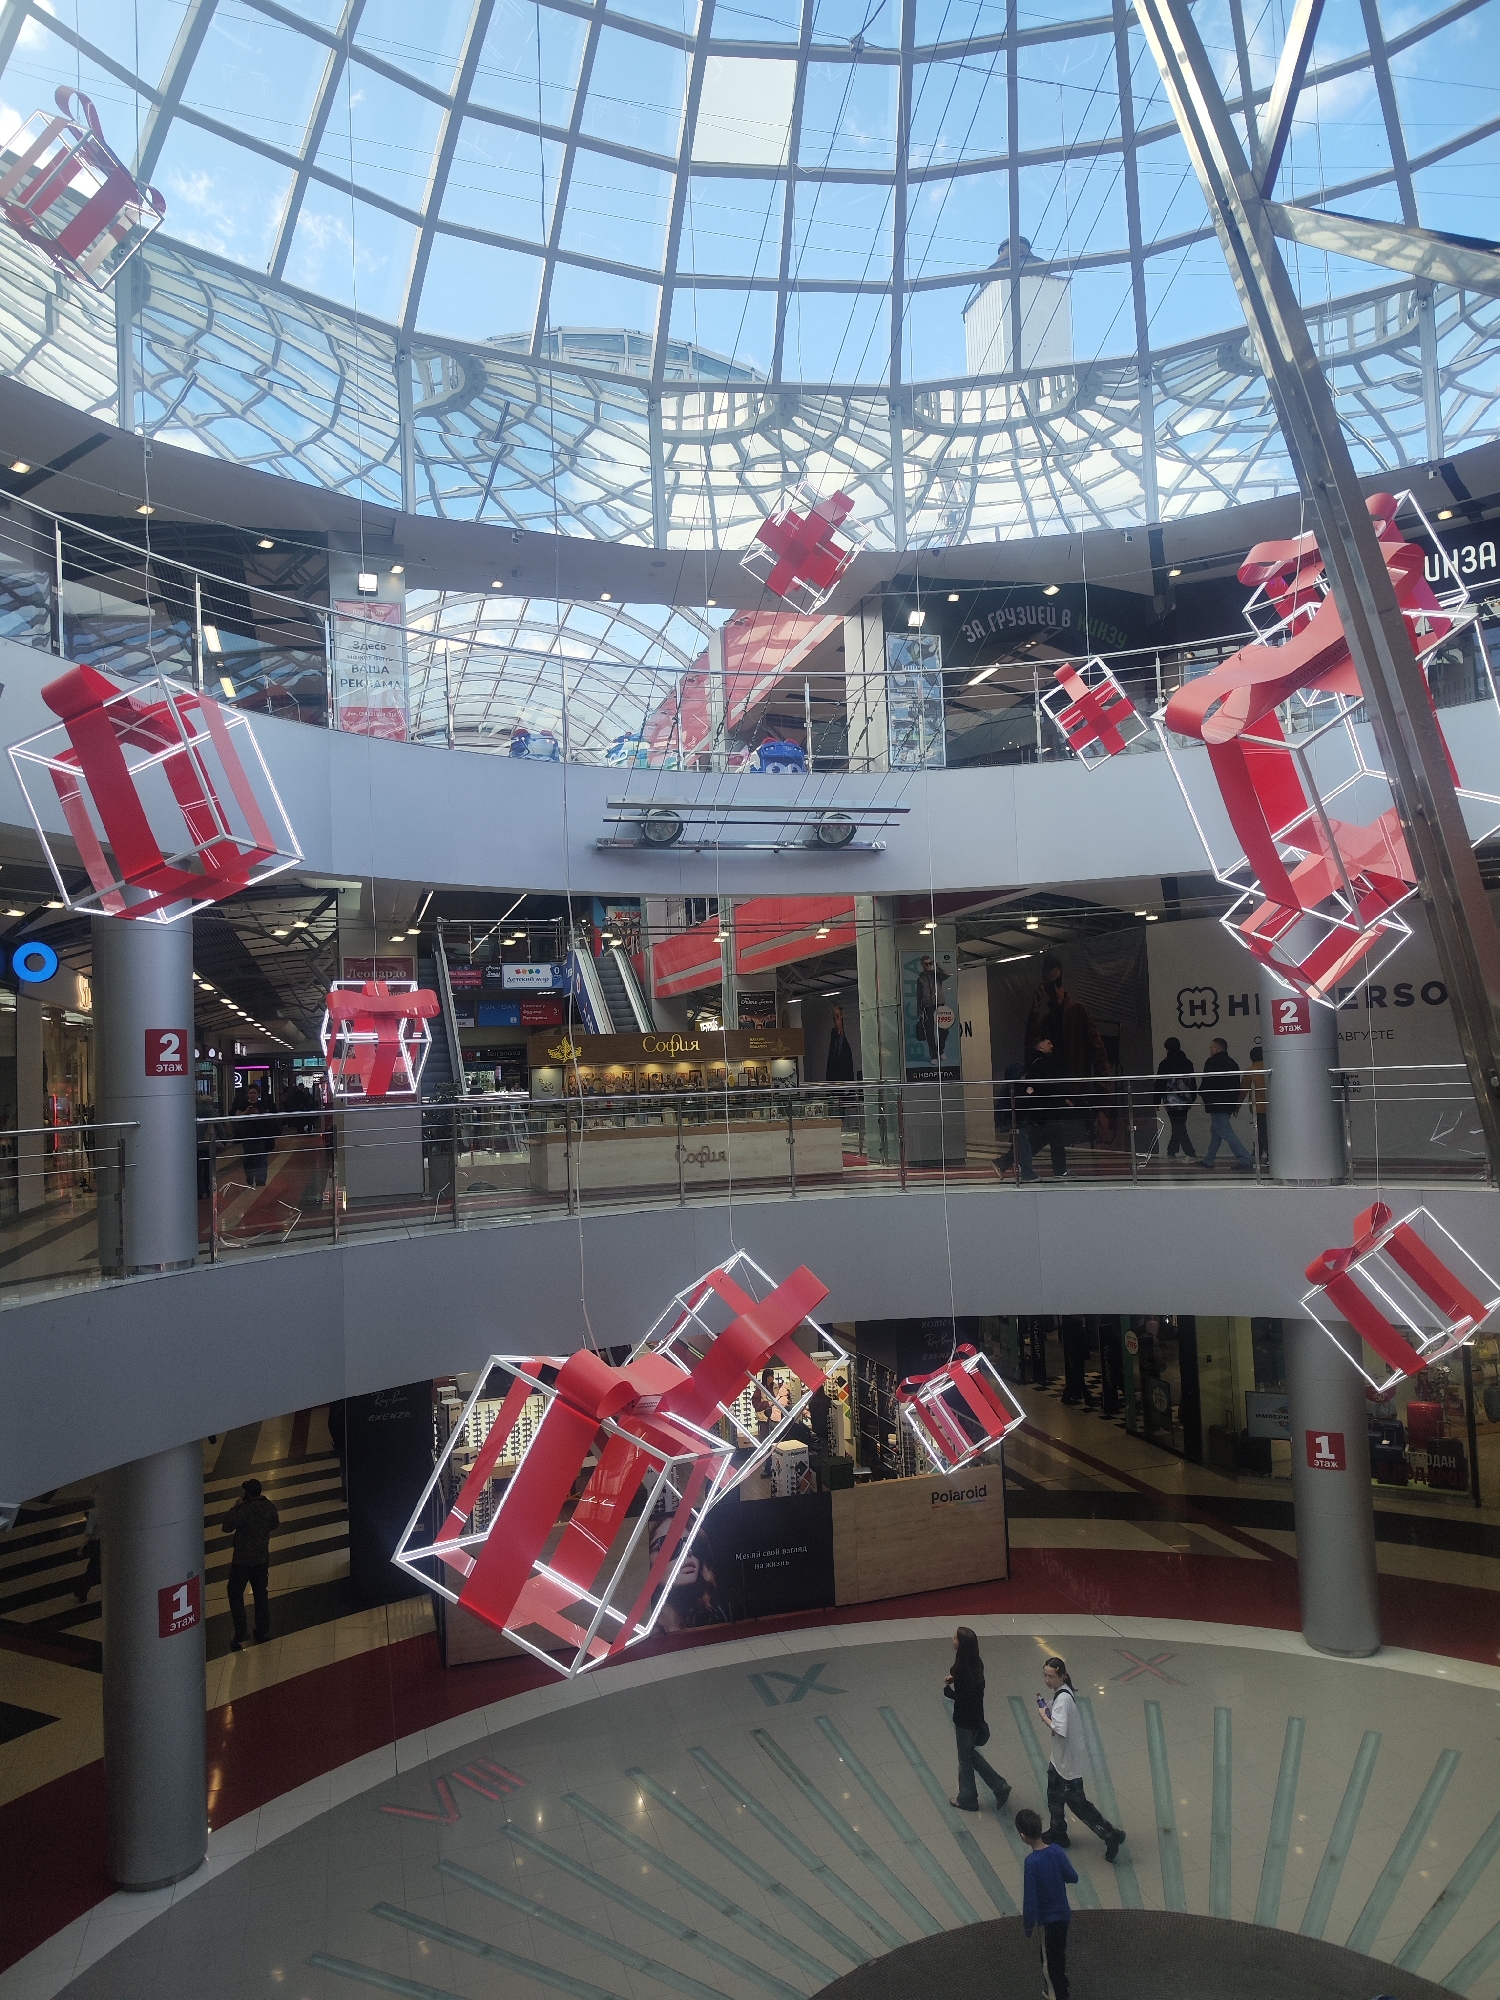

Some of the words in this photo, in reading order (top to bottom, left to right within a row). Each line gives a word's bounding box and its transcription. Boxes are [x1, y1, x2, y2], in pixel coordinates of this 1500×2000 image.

[1425, 541, 1496, 582] ИНЗА
[962, 619, 986, 643] ЗА
[987, 602, 1056, 632] ГРУЗИЕЙ
[352, 640, 387, 651] Здесь
[351, 664, 390, 675] ВАША
[340, 679, 402, 690] РЕКАМА
[346, 968, 407, 980] Леонардо
[506, 976, 534, 984] Детский
[1280, 1001, 1298, 1024] 2
[1278, 1024, 1303, 1033] этаж
[160, 1033, 180, 1062] 2
[643, 1034, 700, 1057] София
[155, 1063, 184, 1073] этаж
[1315, 1435, 1335, 1460] 1
[1313, 1459, 1339, 1469] этаж
[931, 1484, 988, 1505] Polaroid
[762, 1547, 780, 1557] свой
[782, 1544, 808, 1556] взгляд
[754, 1562, 765, 1570] на
[173, 1584, 193, 1620] 1
[169, 1614, 196, 1632] этаж
